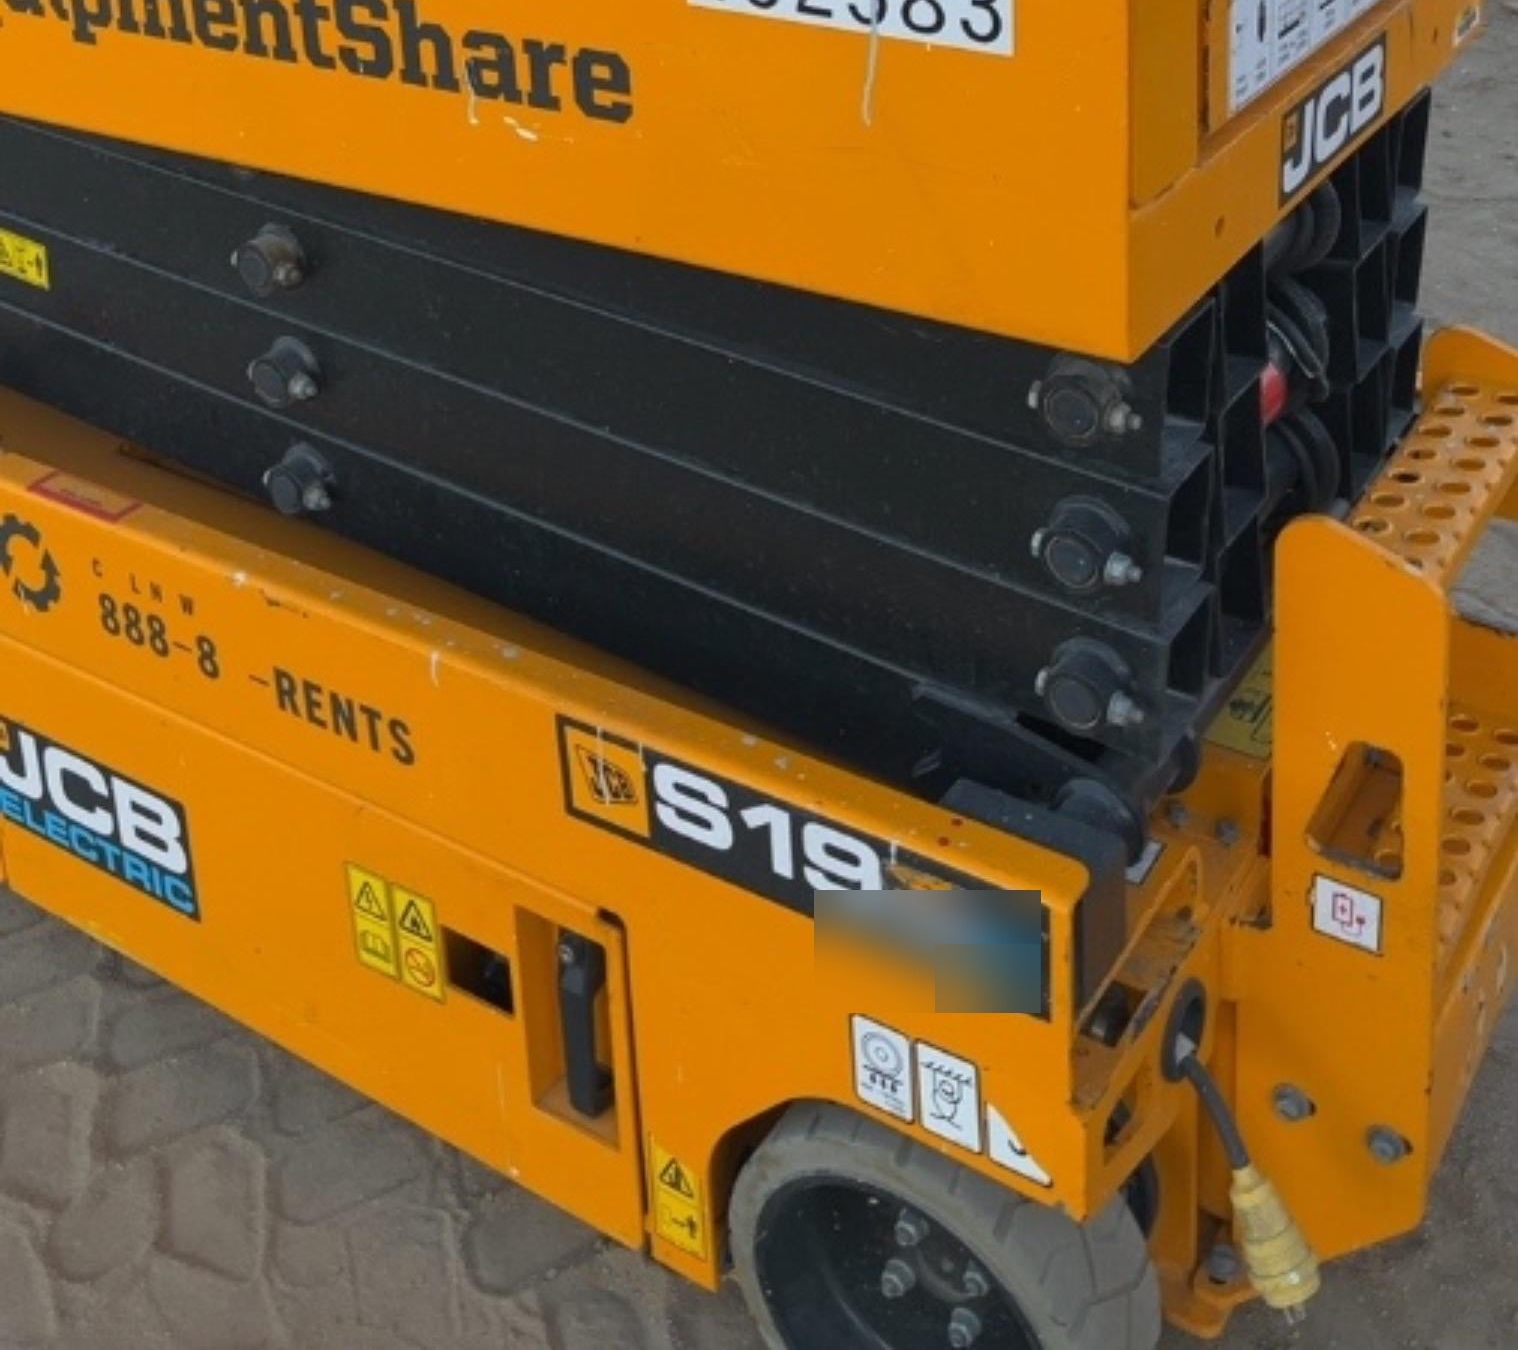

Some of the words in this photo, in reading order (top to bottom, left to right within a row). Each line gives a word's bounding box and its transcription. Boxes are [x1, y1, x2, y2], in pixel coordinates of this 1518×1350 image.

[1282, 43, 1385, 195] JCB
[0, 729, 189, 875] JCB
[0, 783, 195, 914] ELECTRIC
[653, 762, 884, 891] S19
